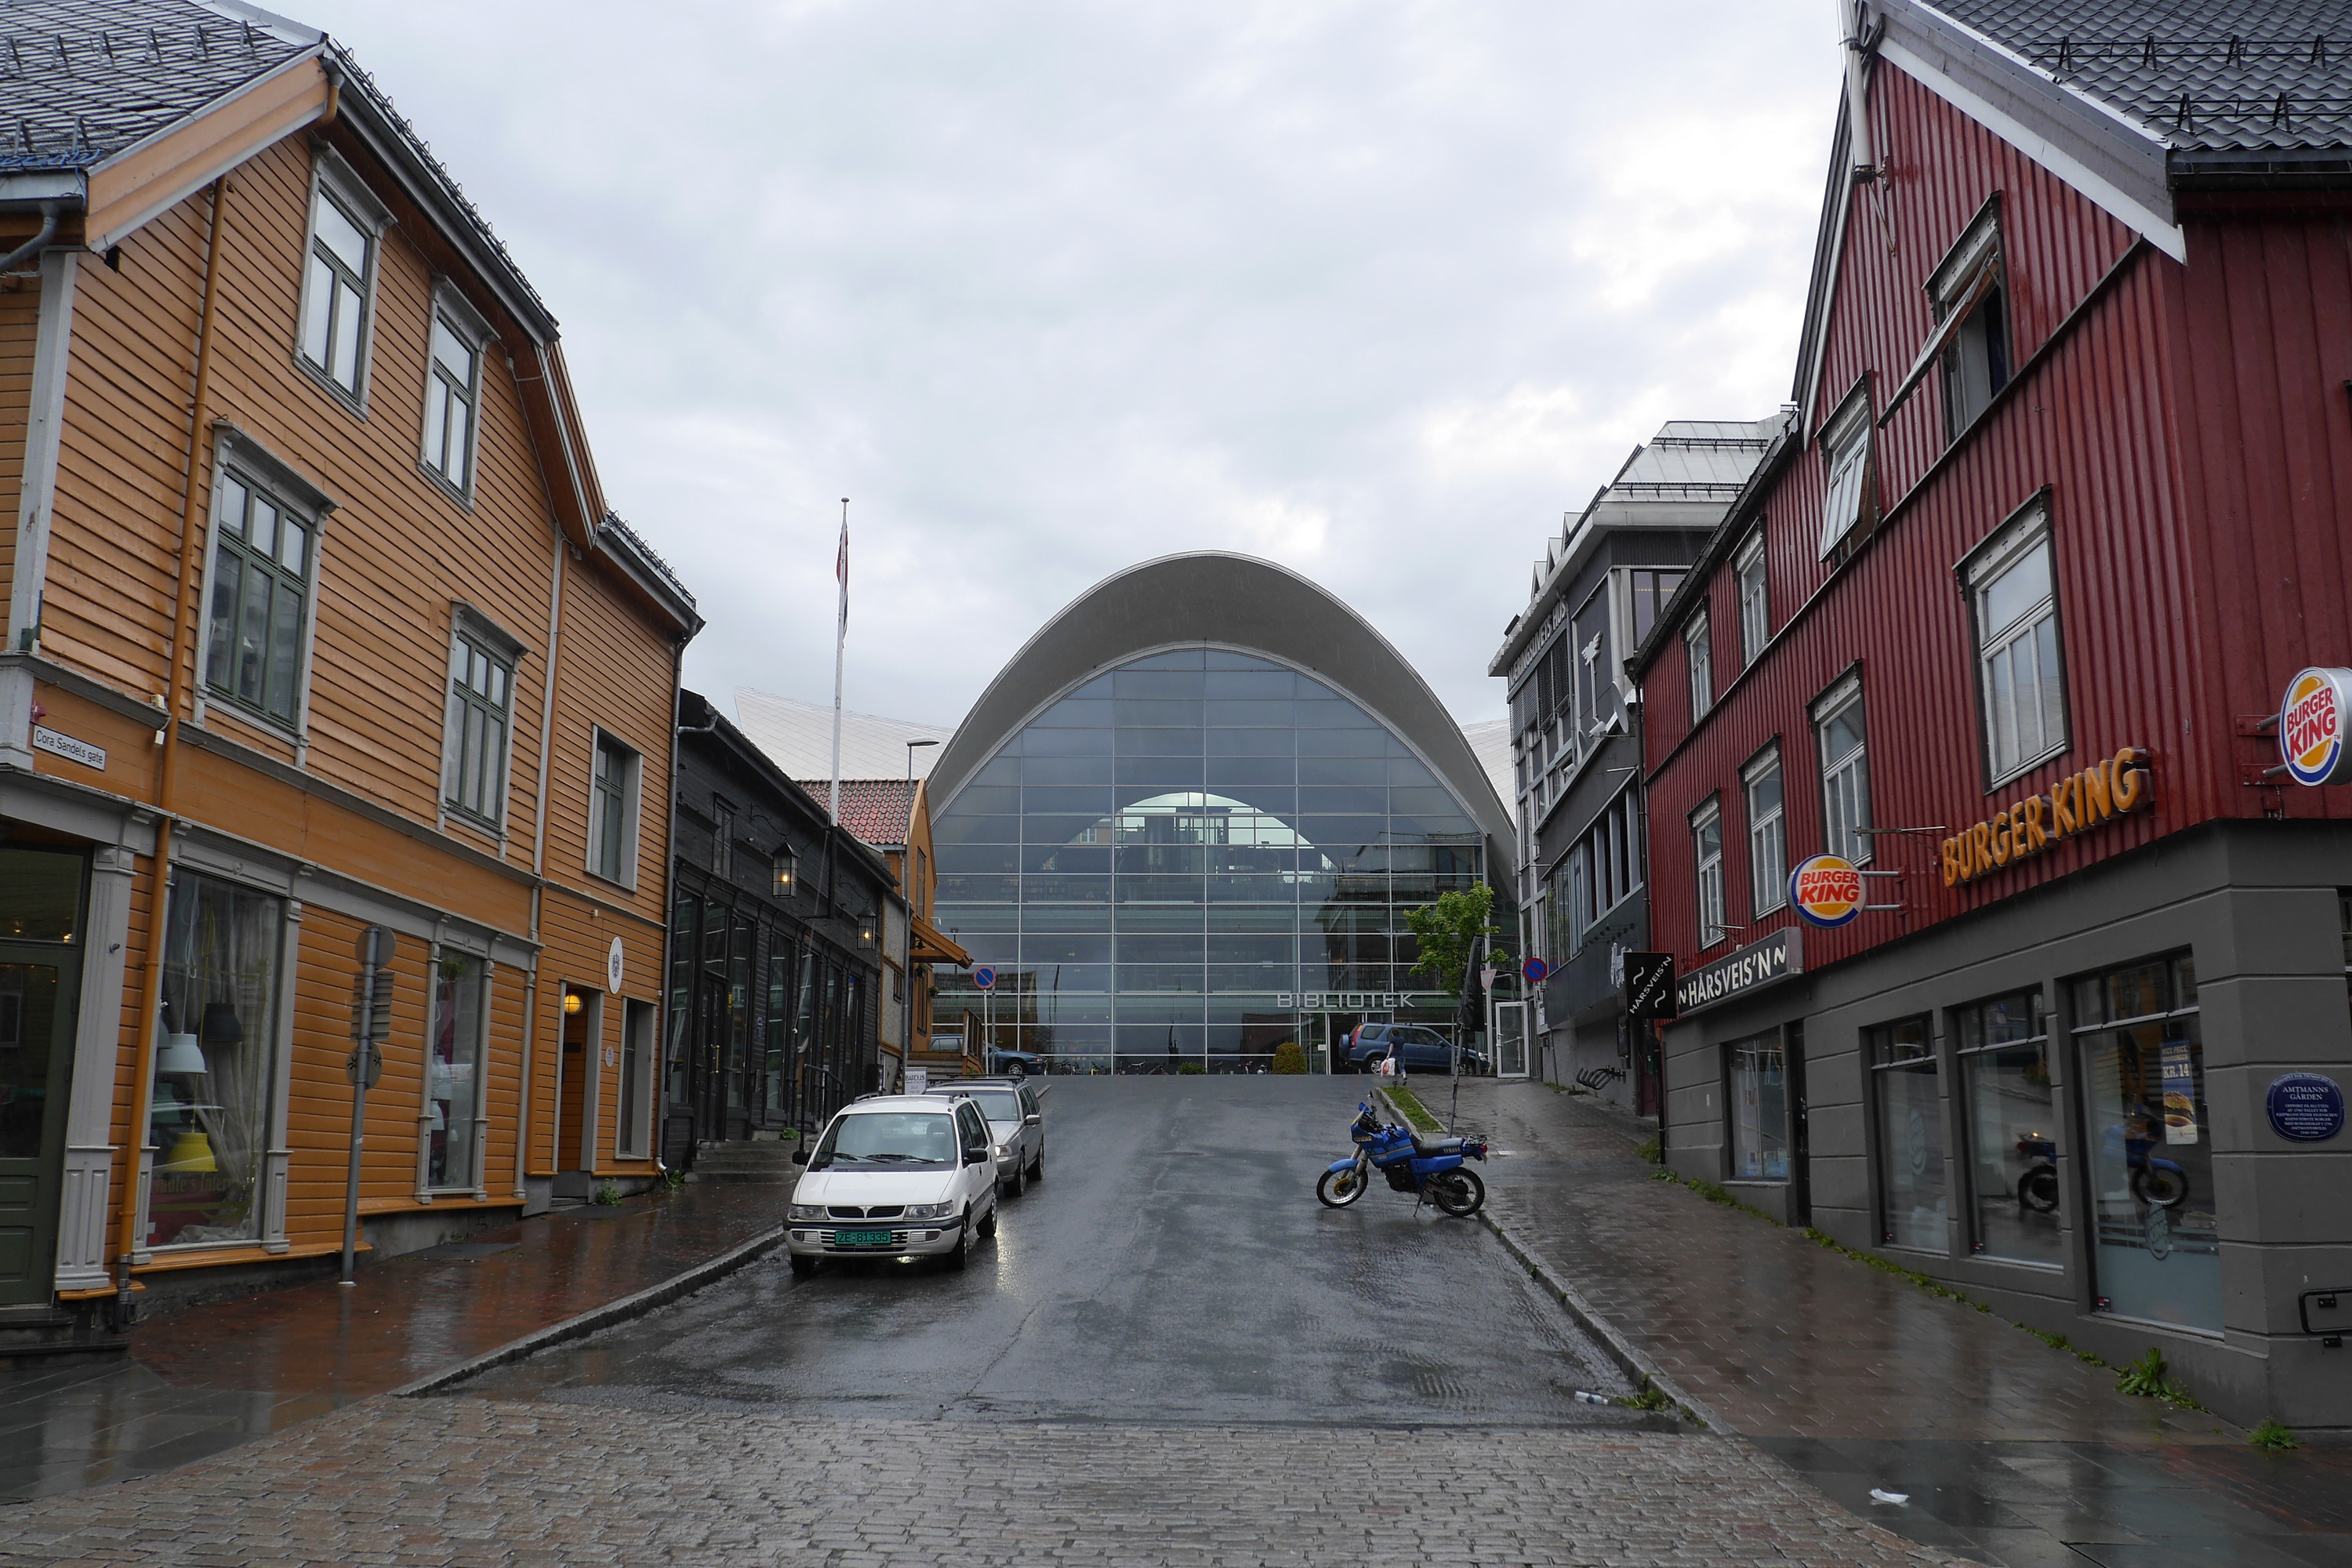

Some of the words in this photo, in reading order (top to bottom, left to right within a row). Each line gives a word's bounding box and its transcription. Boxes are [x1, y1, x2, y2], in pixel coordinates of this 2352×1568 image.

[1552, 600, 1566, 630] HUS
[2287, 687, 2334, 735] BURGER
[36, 730, 54, 746] Cora
[56, 737, 86, 758] Sandels
[88, 751, 103, 764] gate
[2289, 706, 2336, 764] KING
[1942, 793, 2047, 888] BURGER
[2051, 747, 2140, 840] KING
[1799, 884, 1860, 905] KING
[1800, 871, 1860, 886] BURGER
[1629, 956, 1672, 1014] HÅRSVEIS'N
[1687, 947, 1772, 1007] HÅRSVEIS'N
[1277, 993, 1415, 1007] BIBLIOTEK
[2163, 1065, 2179, 1079] KR.
[2180, 1063, 2190, 1077] 14
[838, 1233, 851, 1243] ZE
[857, 1232, 888, 1242] 81335
